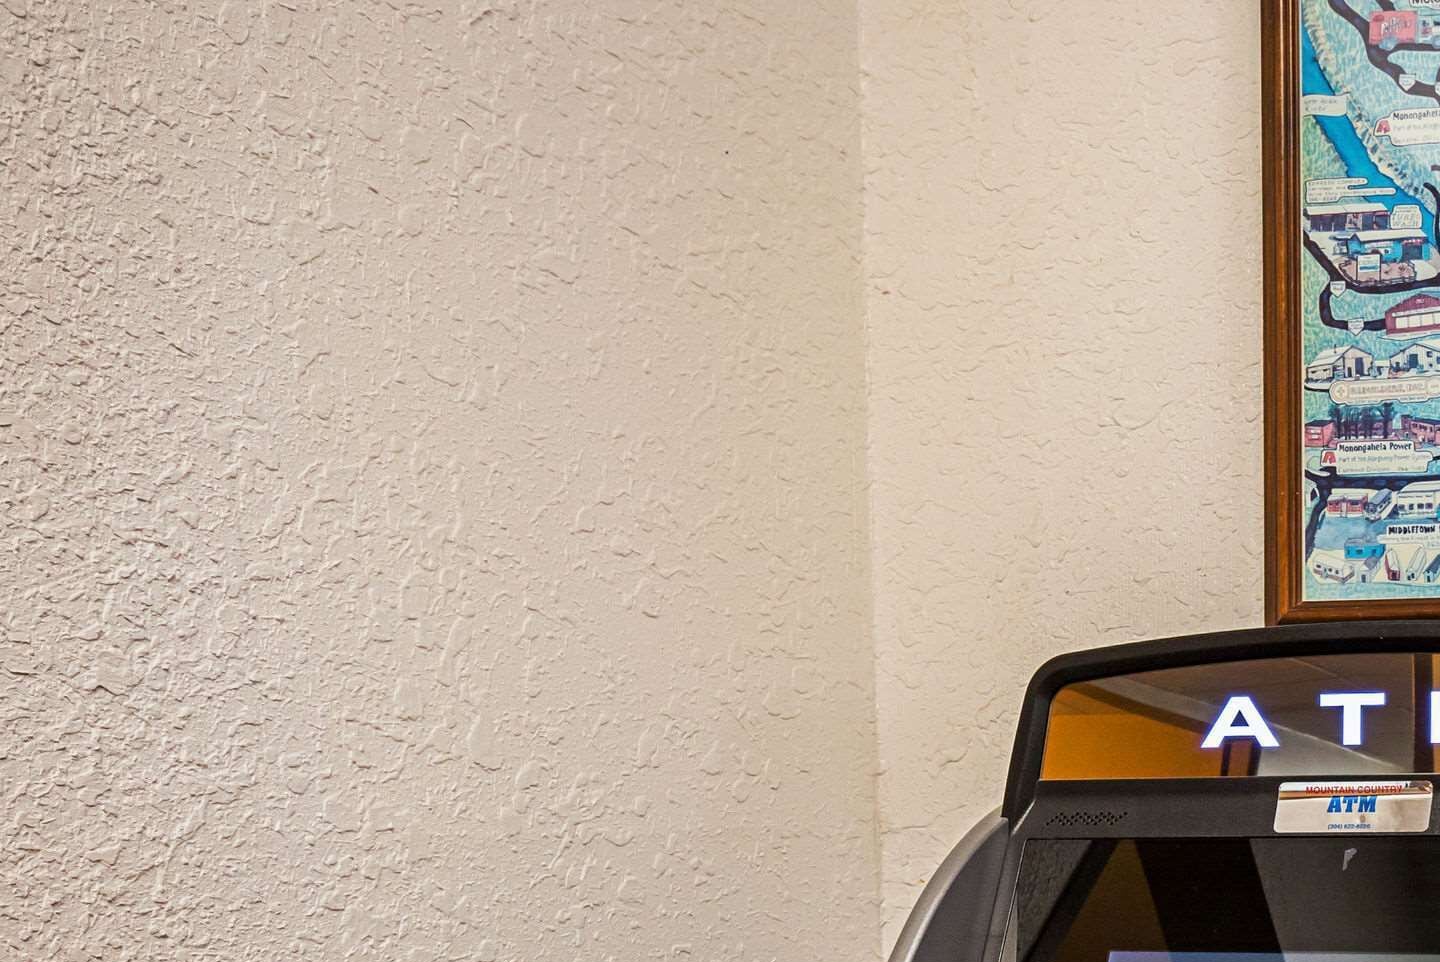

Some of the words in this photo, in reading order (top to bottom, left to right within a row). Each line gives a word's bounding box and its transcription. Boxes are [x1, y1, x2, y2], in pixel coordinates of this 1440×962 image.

[1389, 442, 1412, 450] Power
[1388, 526, 1436, 535] MIDDLETOWN
[1306, 785, 1354, 795] MOUNTAIN
[1357, 784, 1403, 794] COUNTRY
[1327, 795, 1377, 813] ATM
